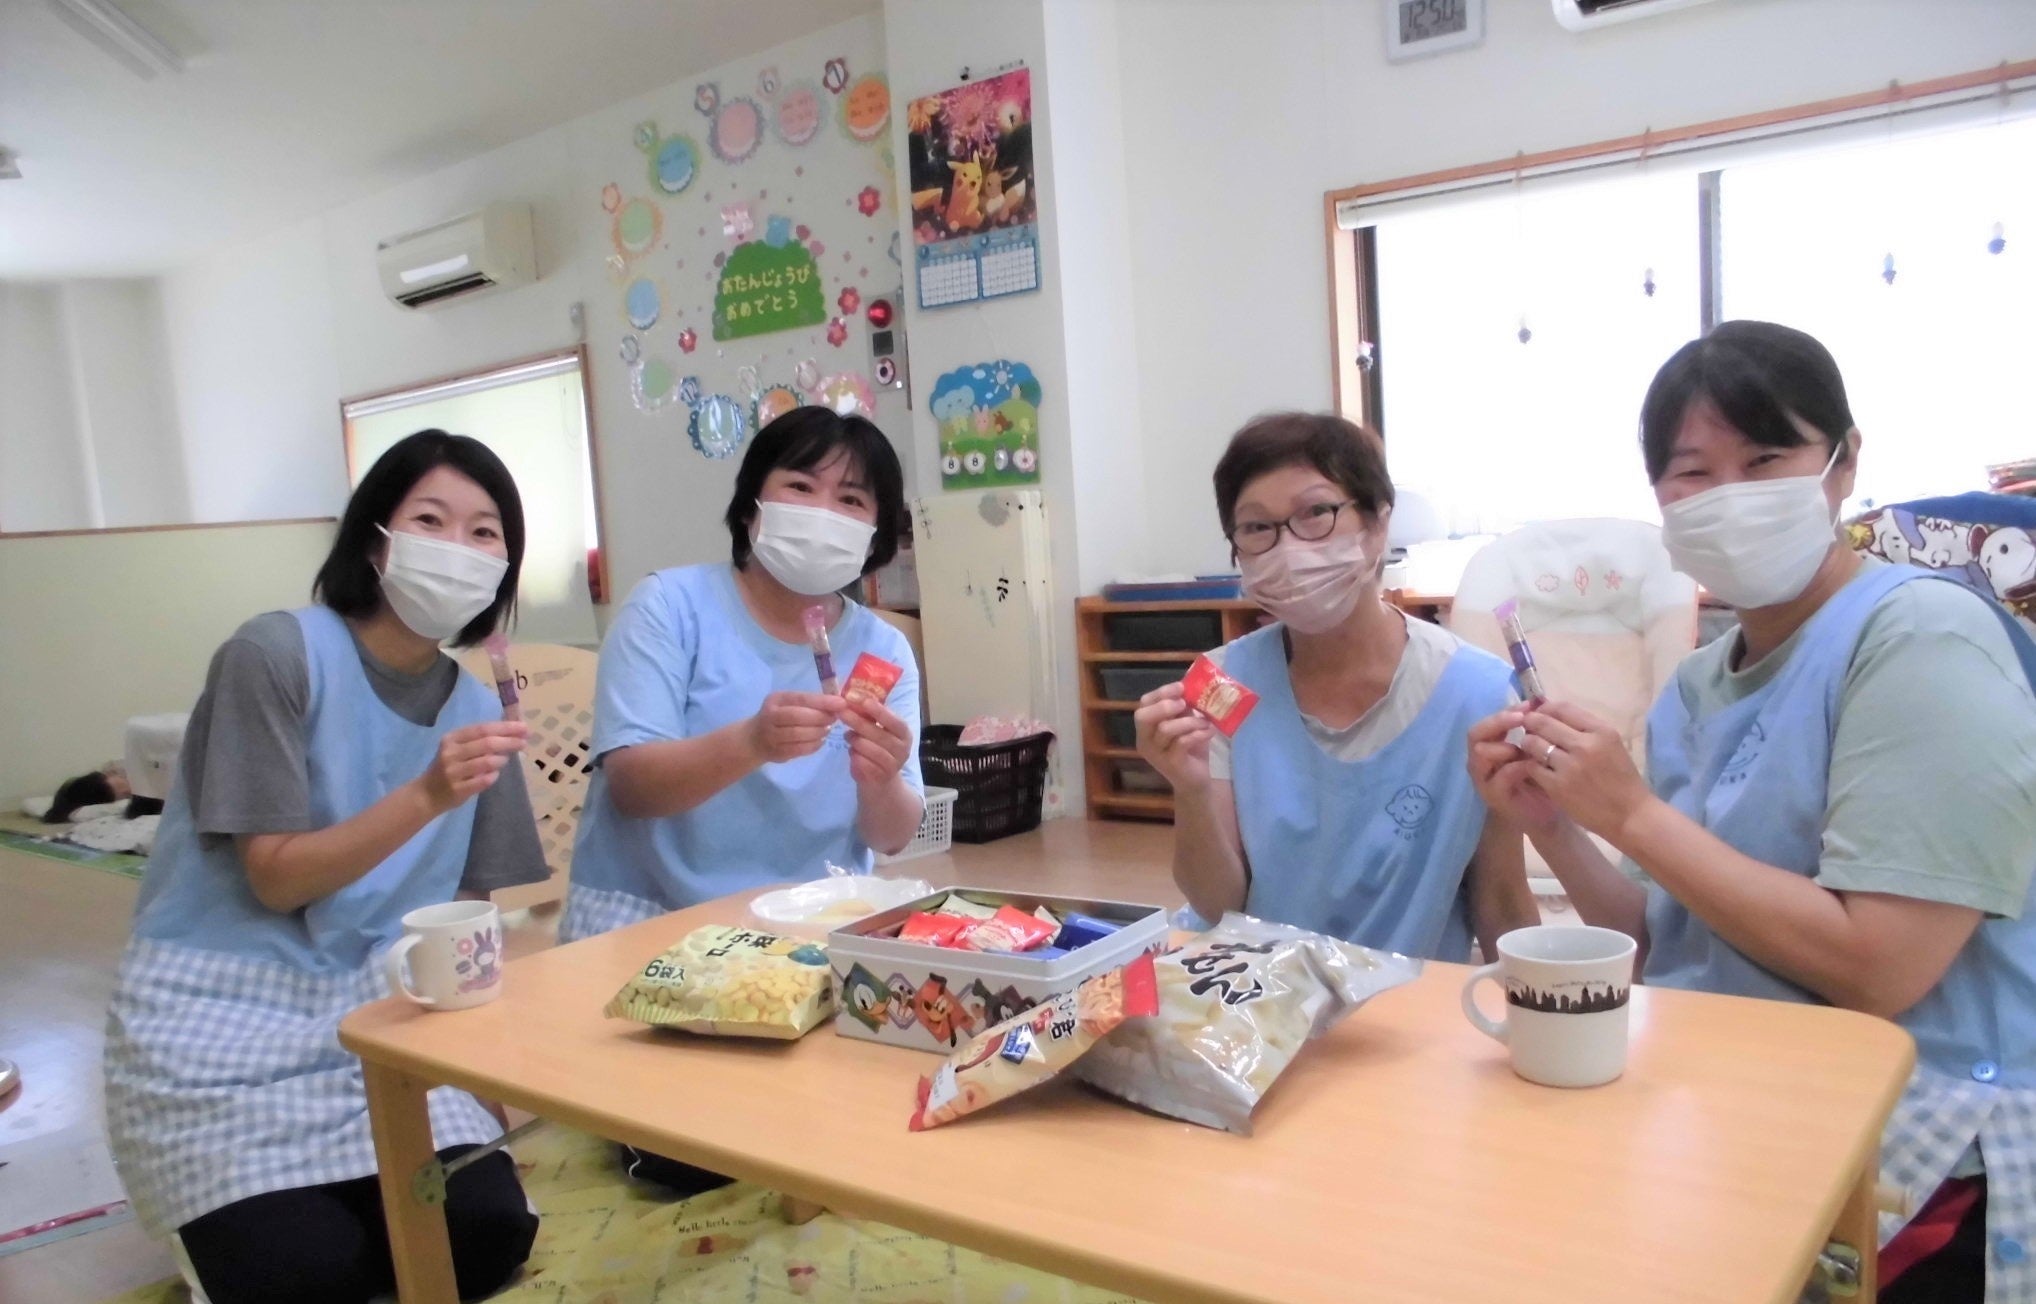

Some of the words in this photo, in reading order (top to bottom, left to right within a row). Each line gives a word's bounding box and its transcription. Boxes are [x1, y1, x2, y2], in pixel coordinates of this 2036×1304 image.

[722, 263, 810, 296] おたんじょうび
[726, 289, 799, 322] おめでとう
[644, 959, 685, 981] 6袋入
